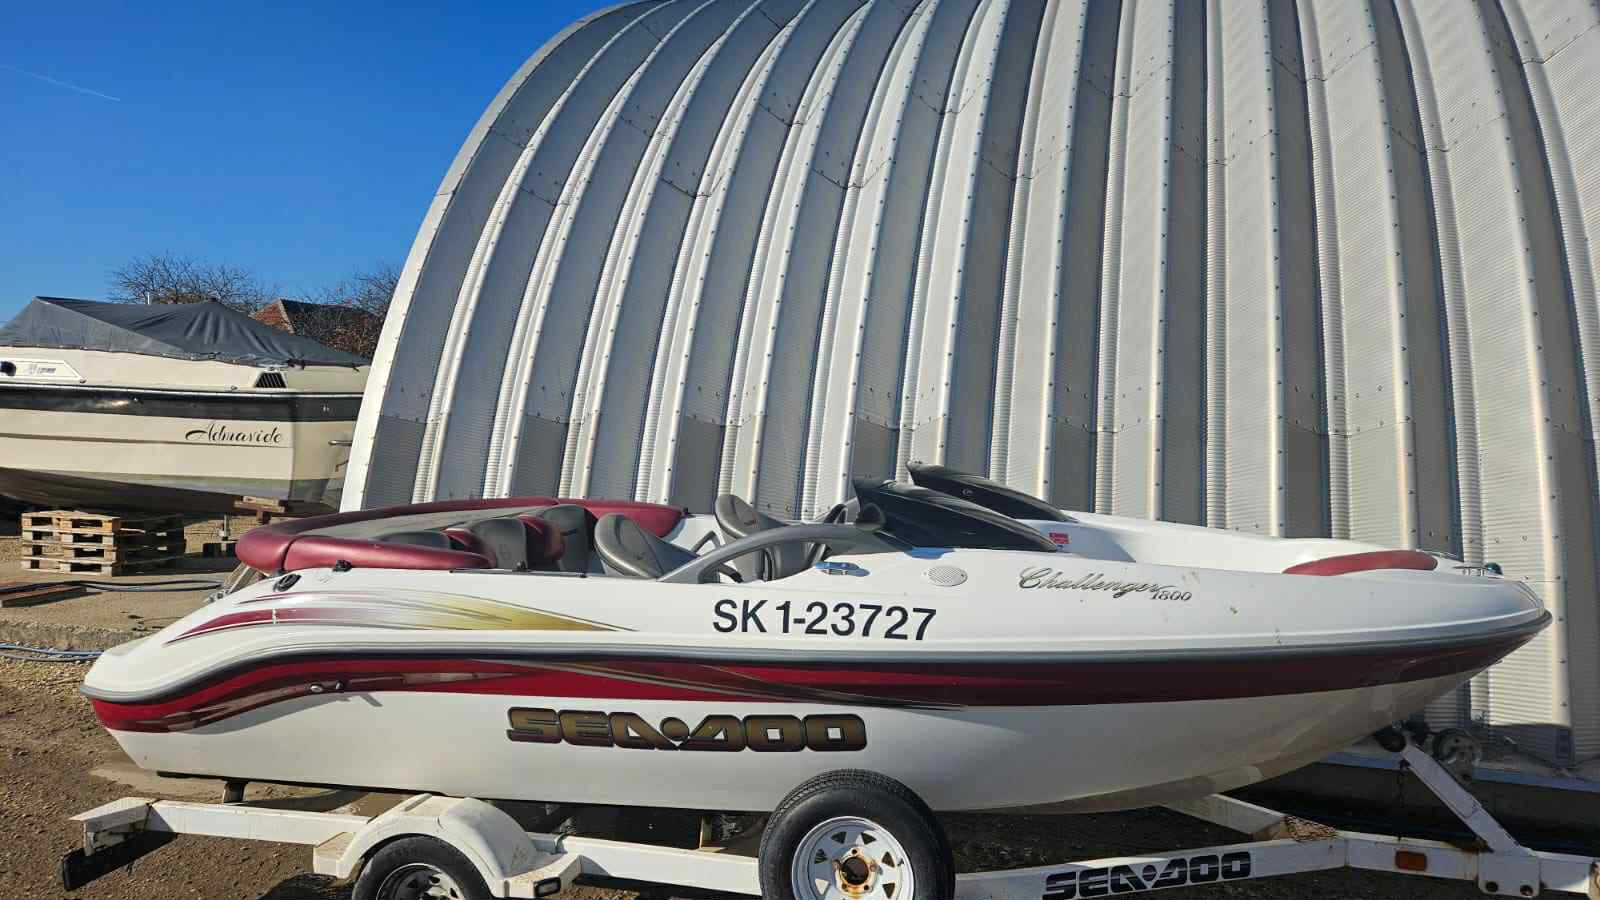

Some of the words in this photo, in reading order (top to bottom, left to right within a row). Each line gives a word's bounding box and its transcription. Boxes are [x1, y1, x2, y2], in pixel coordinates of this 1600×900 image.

[1019, 567, 1176, 599] Challenger
[1150, 590, 1192, 601] 1800
[713, 599, 768, 633] SK
[776, 601, 937, 641] 1-23727
